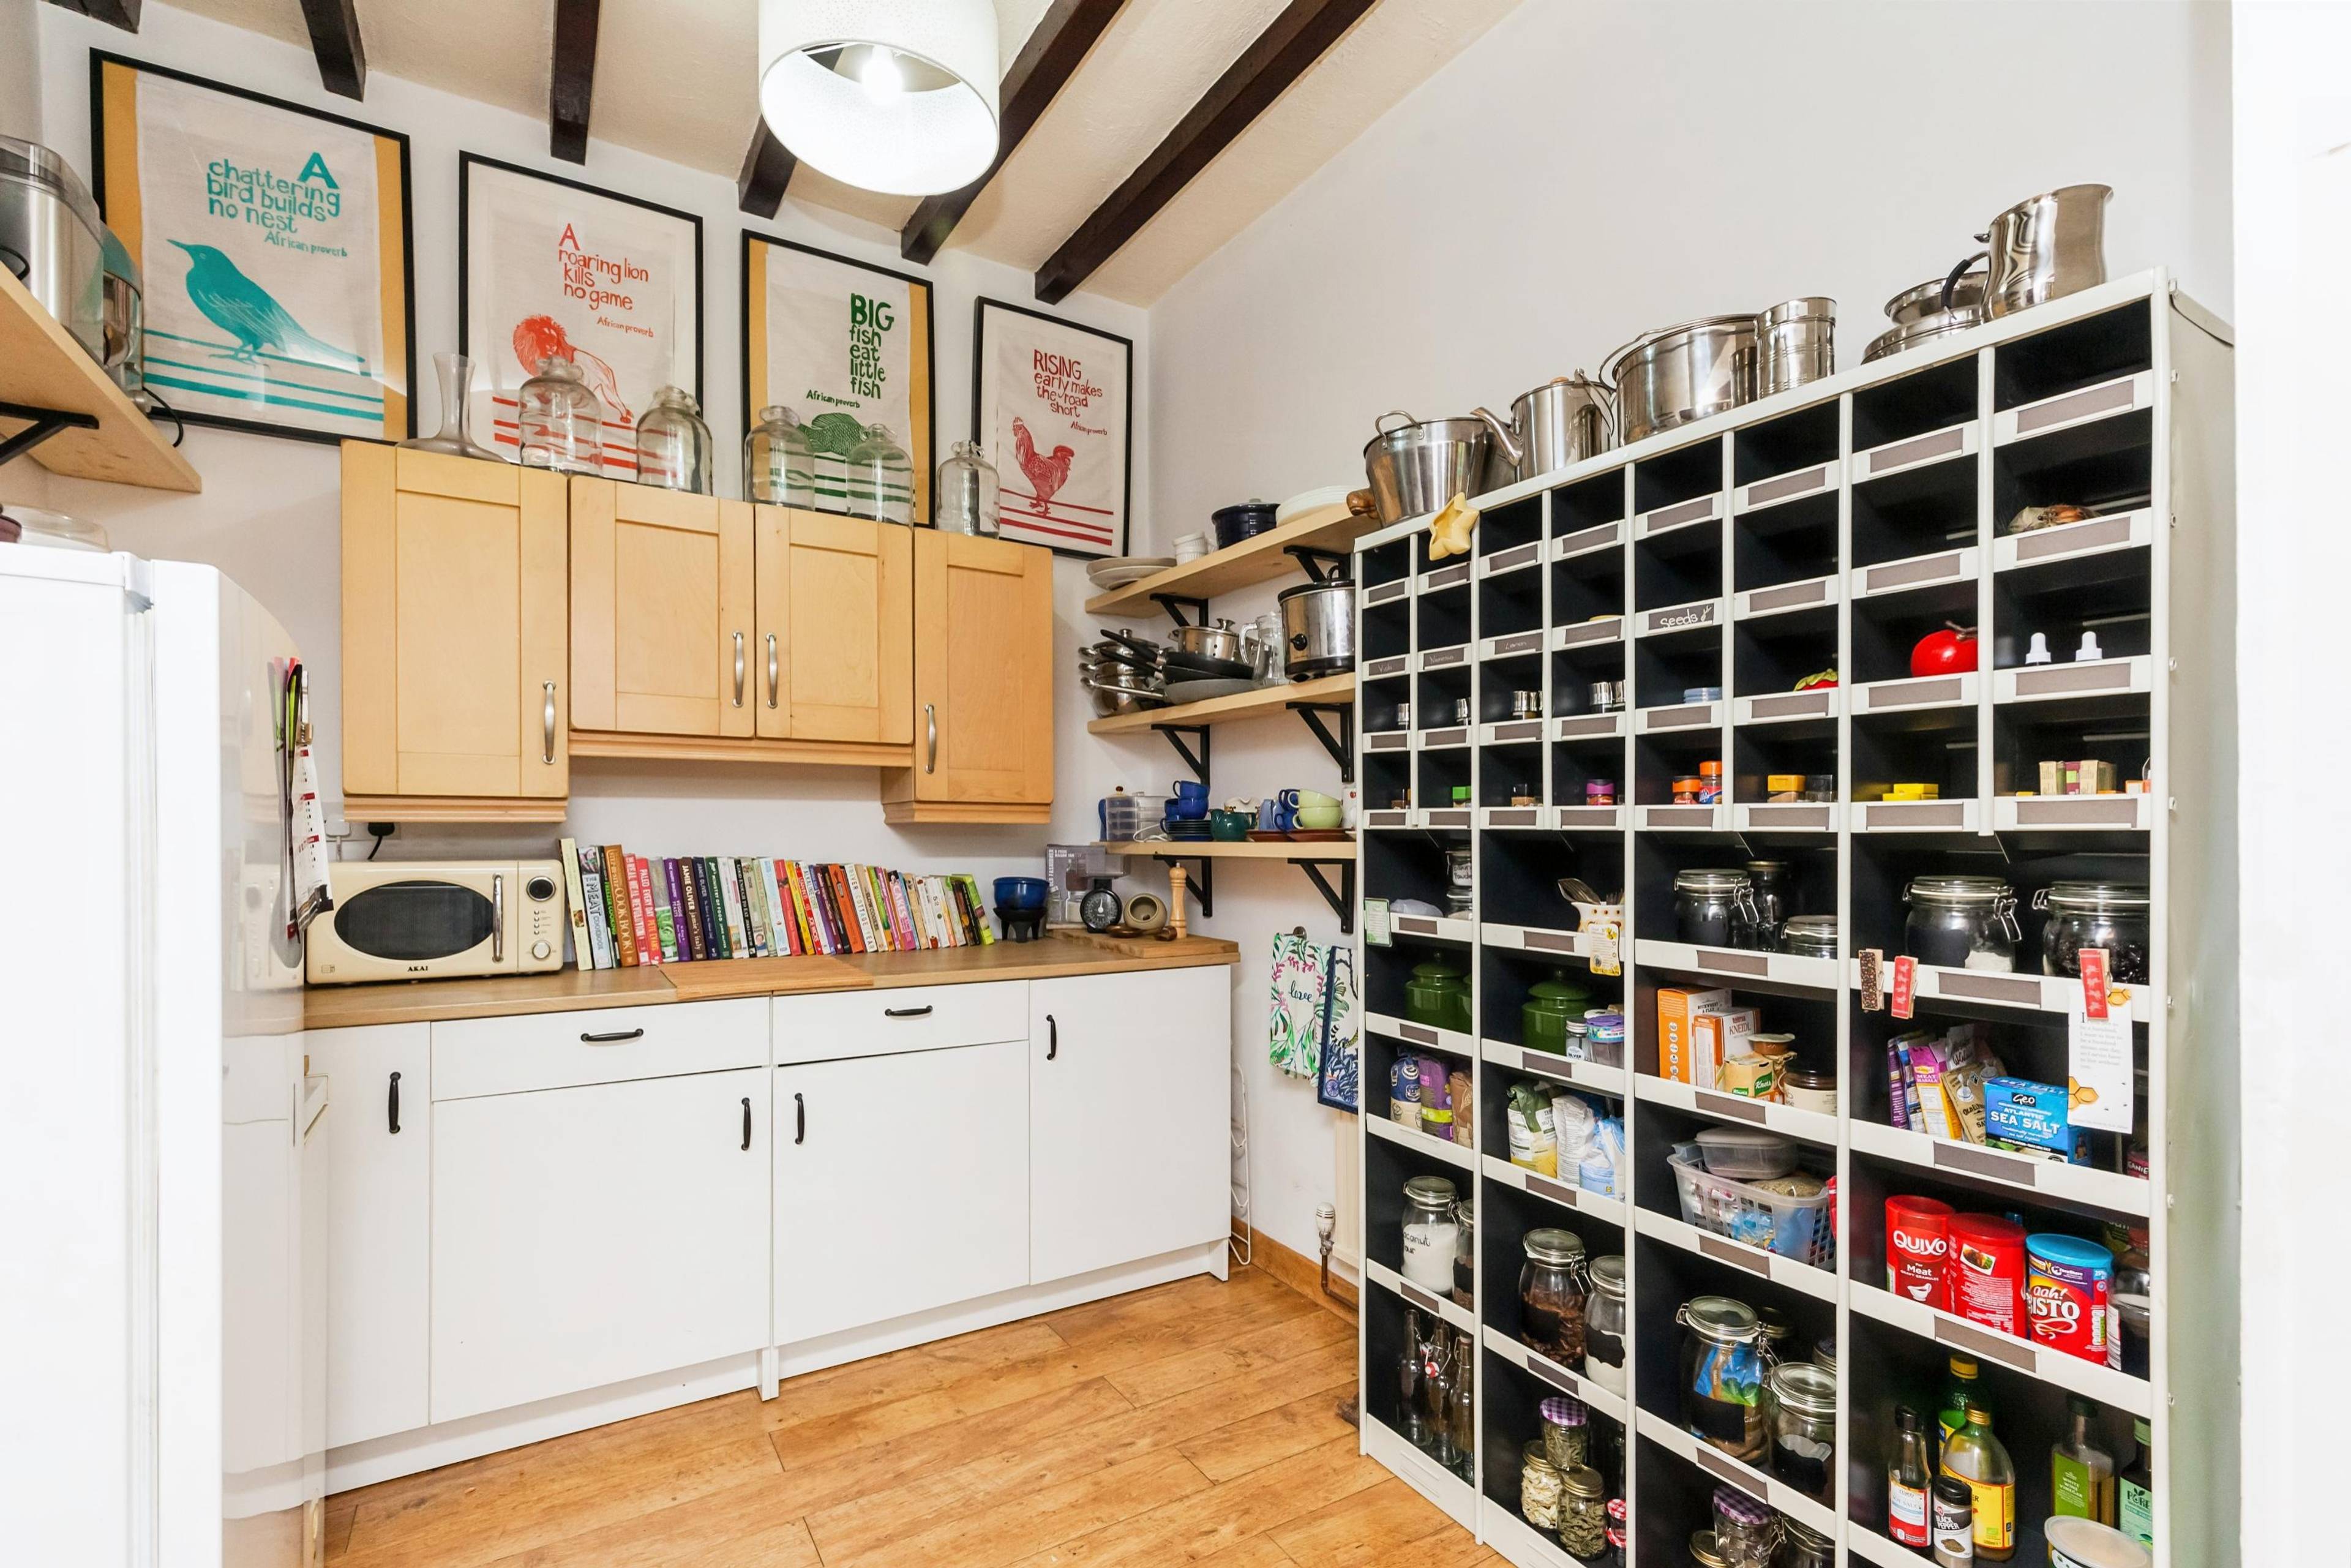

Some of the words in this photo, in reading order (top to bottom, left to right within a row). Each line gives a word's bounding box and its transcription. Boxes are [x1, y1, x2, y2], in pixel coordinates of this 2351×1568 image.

[297, 152, 340, 189] A
[206, 173, 254, 204] bird
[261, 189, 326, 222] builds
[209, 159, 340, 217] chattering
[209, 197, 239, 219] no
[246, 206, 298, 233] nest
[264, 231, 309, 252] African
[311, 244, 348, 257] proverb
[559, 223, 580, 250] A
[558, 249, 621, 284] roaring
[624, 258, 649, 282] lion
[564, 263, 595, 287] kills
[564, 283, 586, 299] no
[589, 290, 632, 310] game
[850, 293, 894, 331] BIG
[597, 316, 624, 329] African
[625, 325, 654, 337] proverb
[849, 324, 881, 347] fish
[850, 344, 880, 362] eat
[1033, 349, 1081, 380] RISING
[850, 358, 886, 382] little
[850, 377, 880, 399] fish
[1034, 372, 1069, 398] early
[1071, 379, 1103, 397] makes
[1037, 385, 1056, 402] the
[1064, 394, 1088, 407] road
[806, 389, 834, 403] African
[836, 398, 860, 408] proverb
[1050, 402, 1080, 418] short
[1071, 421, 1087, 432] African
[1660, 608, 1698, 628] seeds
[639, 869, 650, 887] PALEO
[682, 865, 691, 885] JAMIE
[804, 870, 813, 895] ALKALINE
[587, 883, 602, 916] MEAT
[643, 888, 652, 906] EVERY
[686, 887, 696, 910] OLIVER
[893, 887, 907, 918] CAKES
[855, 893, 868, 926] COTTAGE
[593, 916, 604, 950] COOKBOOK
[1729, 1023, 1752, 1035] KNEIDL
[2013, 1094, 2035, 1105] Geo
[1990, 1111, 2018, 1125] SEA
[2022, 1117, 2060, 1134] SALT
[2004, 1108, 2044, 1120] ATLANTIC
[1403, 1232, 1431, 1247] oconut
[1404, 1245, 1416, 1255] our
[1893, 1230, 1947, 1256] QUIXO
[1907, 1264, 1932, 1276] Meat
[2033, 1286, 2068, 1299] aah!
